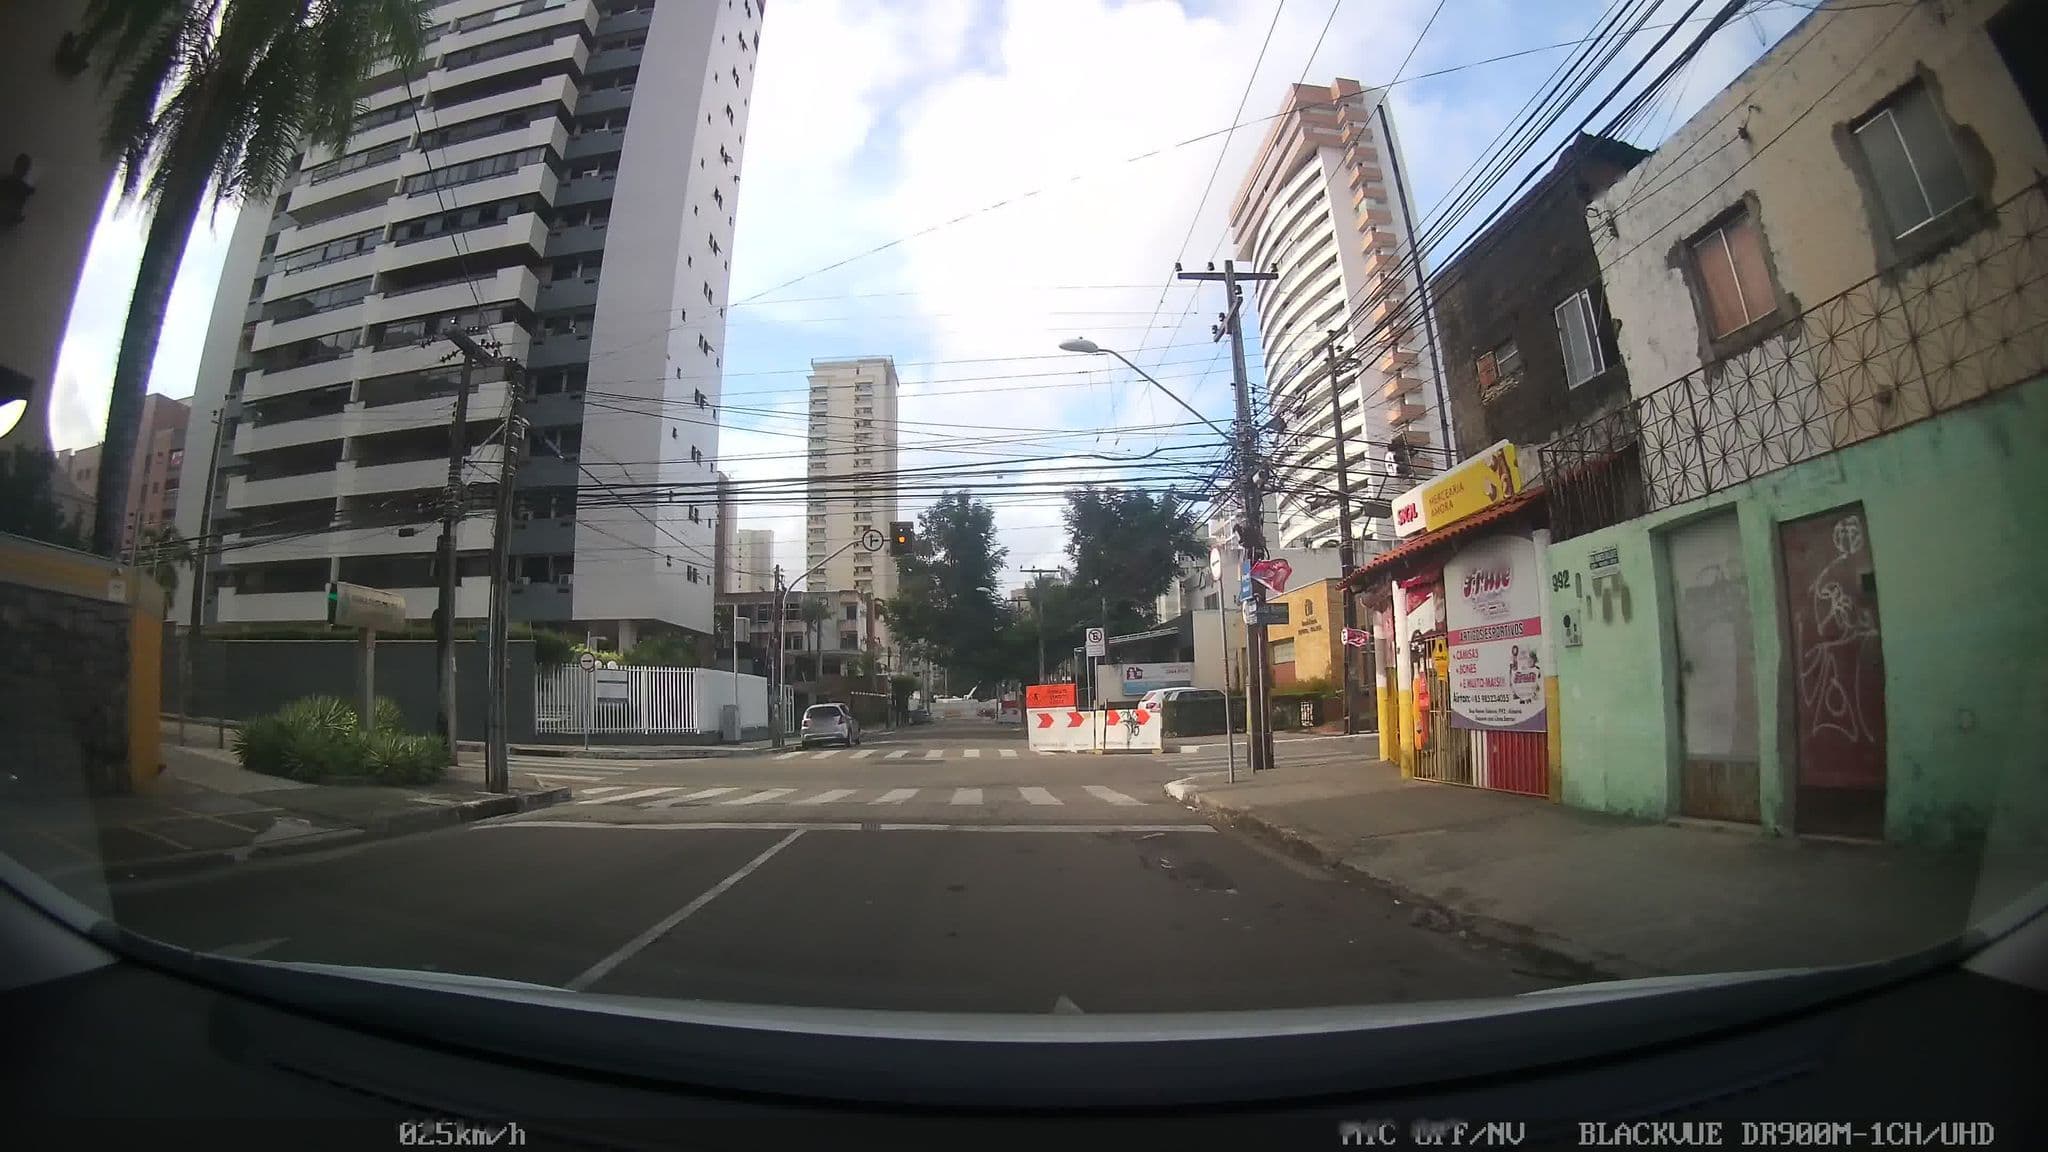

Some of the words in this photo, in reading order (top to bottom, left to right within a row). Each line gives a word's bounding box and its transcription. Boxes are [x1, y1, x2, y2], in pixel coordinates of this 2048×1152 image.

[1429, 482, 1465, 505] MERCEARIA
[1431, 500, 1454, 517] AMORA
[1552, 569, 1571, 592] 992
[1484, 622, 1524, 640] ESPORTIVOS
[1456, 647, 1479, 660] CAMISAS
